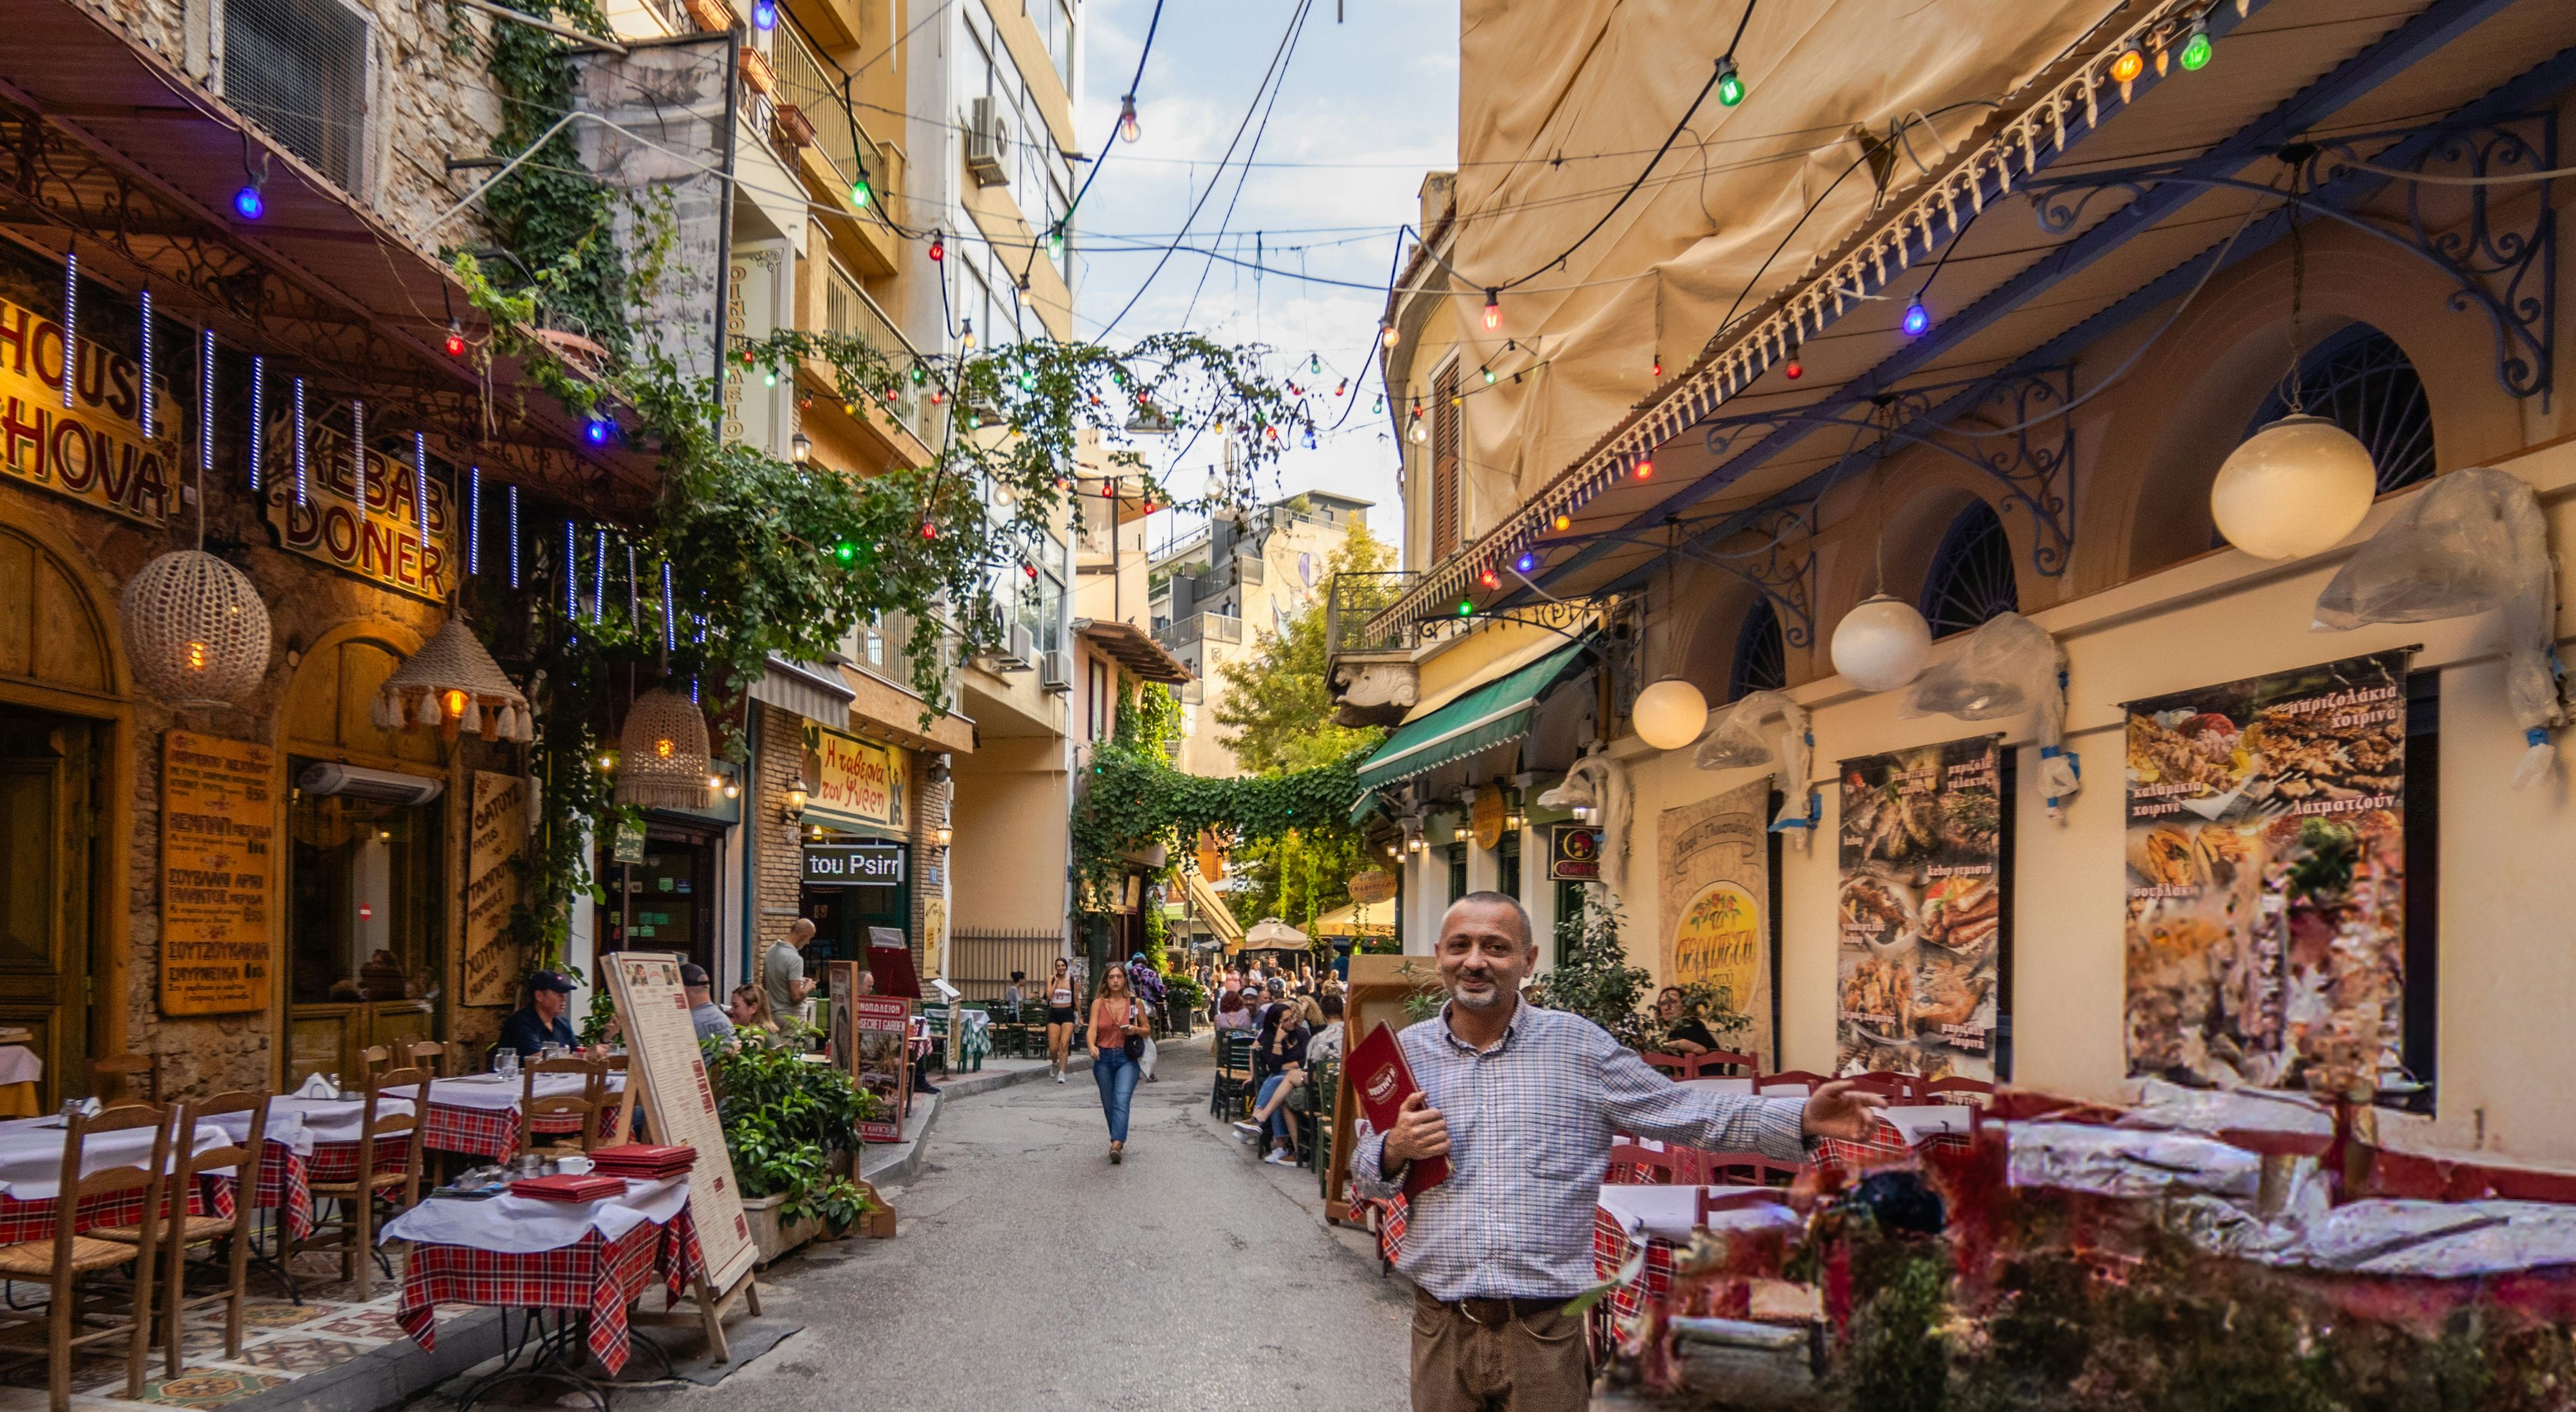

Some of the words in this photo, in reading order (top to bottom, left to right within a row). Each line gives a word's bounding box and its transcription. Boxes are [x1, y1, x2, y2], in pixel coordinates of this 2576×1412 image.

[0, 395, 169, 522] HOVA
[311, 426, 446, 535] KEBAB
[286, 488, 446, 597] DONER
[2289, 685, 2397, 719] μπριζολάκια
[809, 854, 843, 874] tou
[850, 854, 898, 875] Psirr
[858, 1002, 901, 1014] ΝΟΠΩΛΕΙΟΝ
[860, 1018, 882, 1030] SECRET
[883, 1020, 906, 1032] GARDEN
